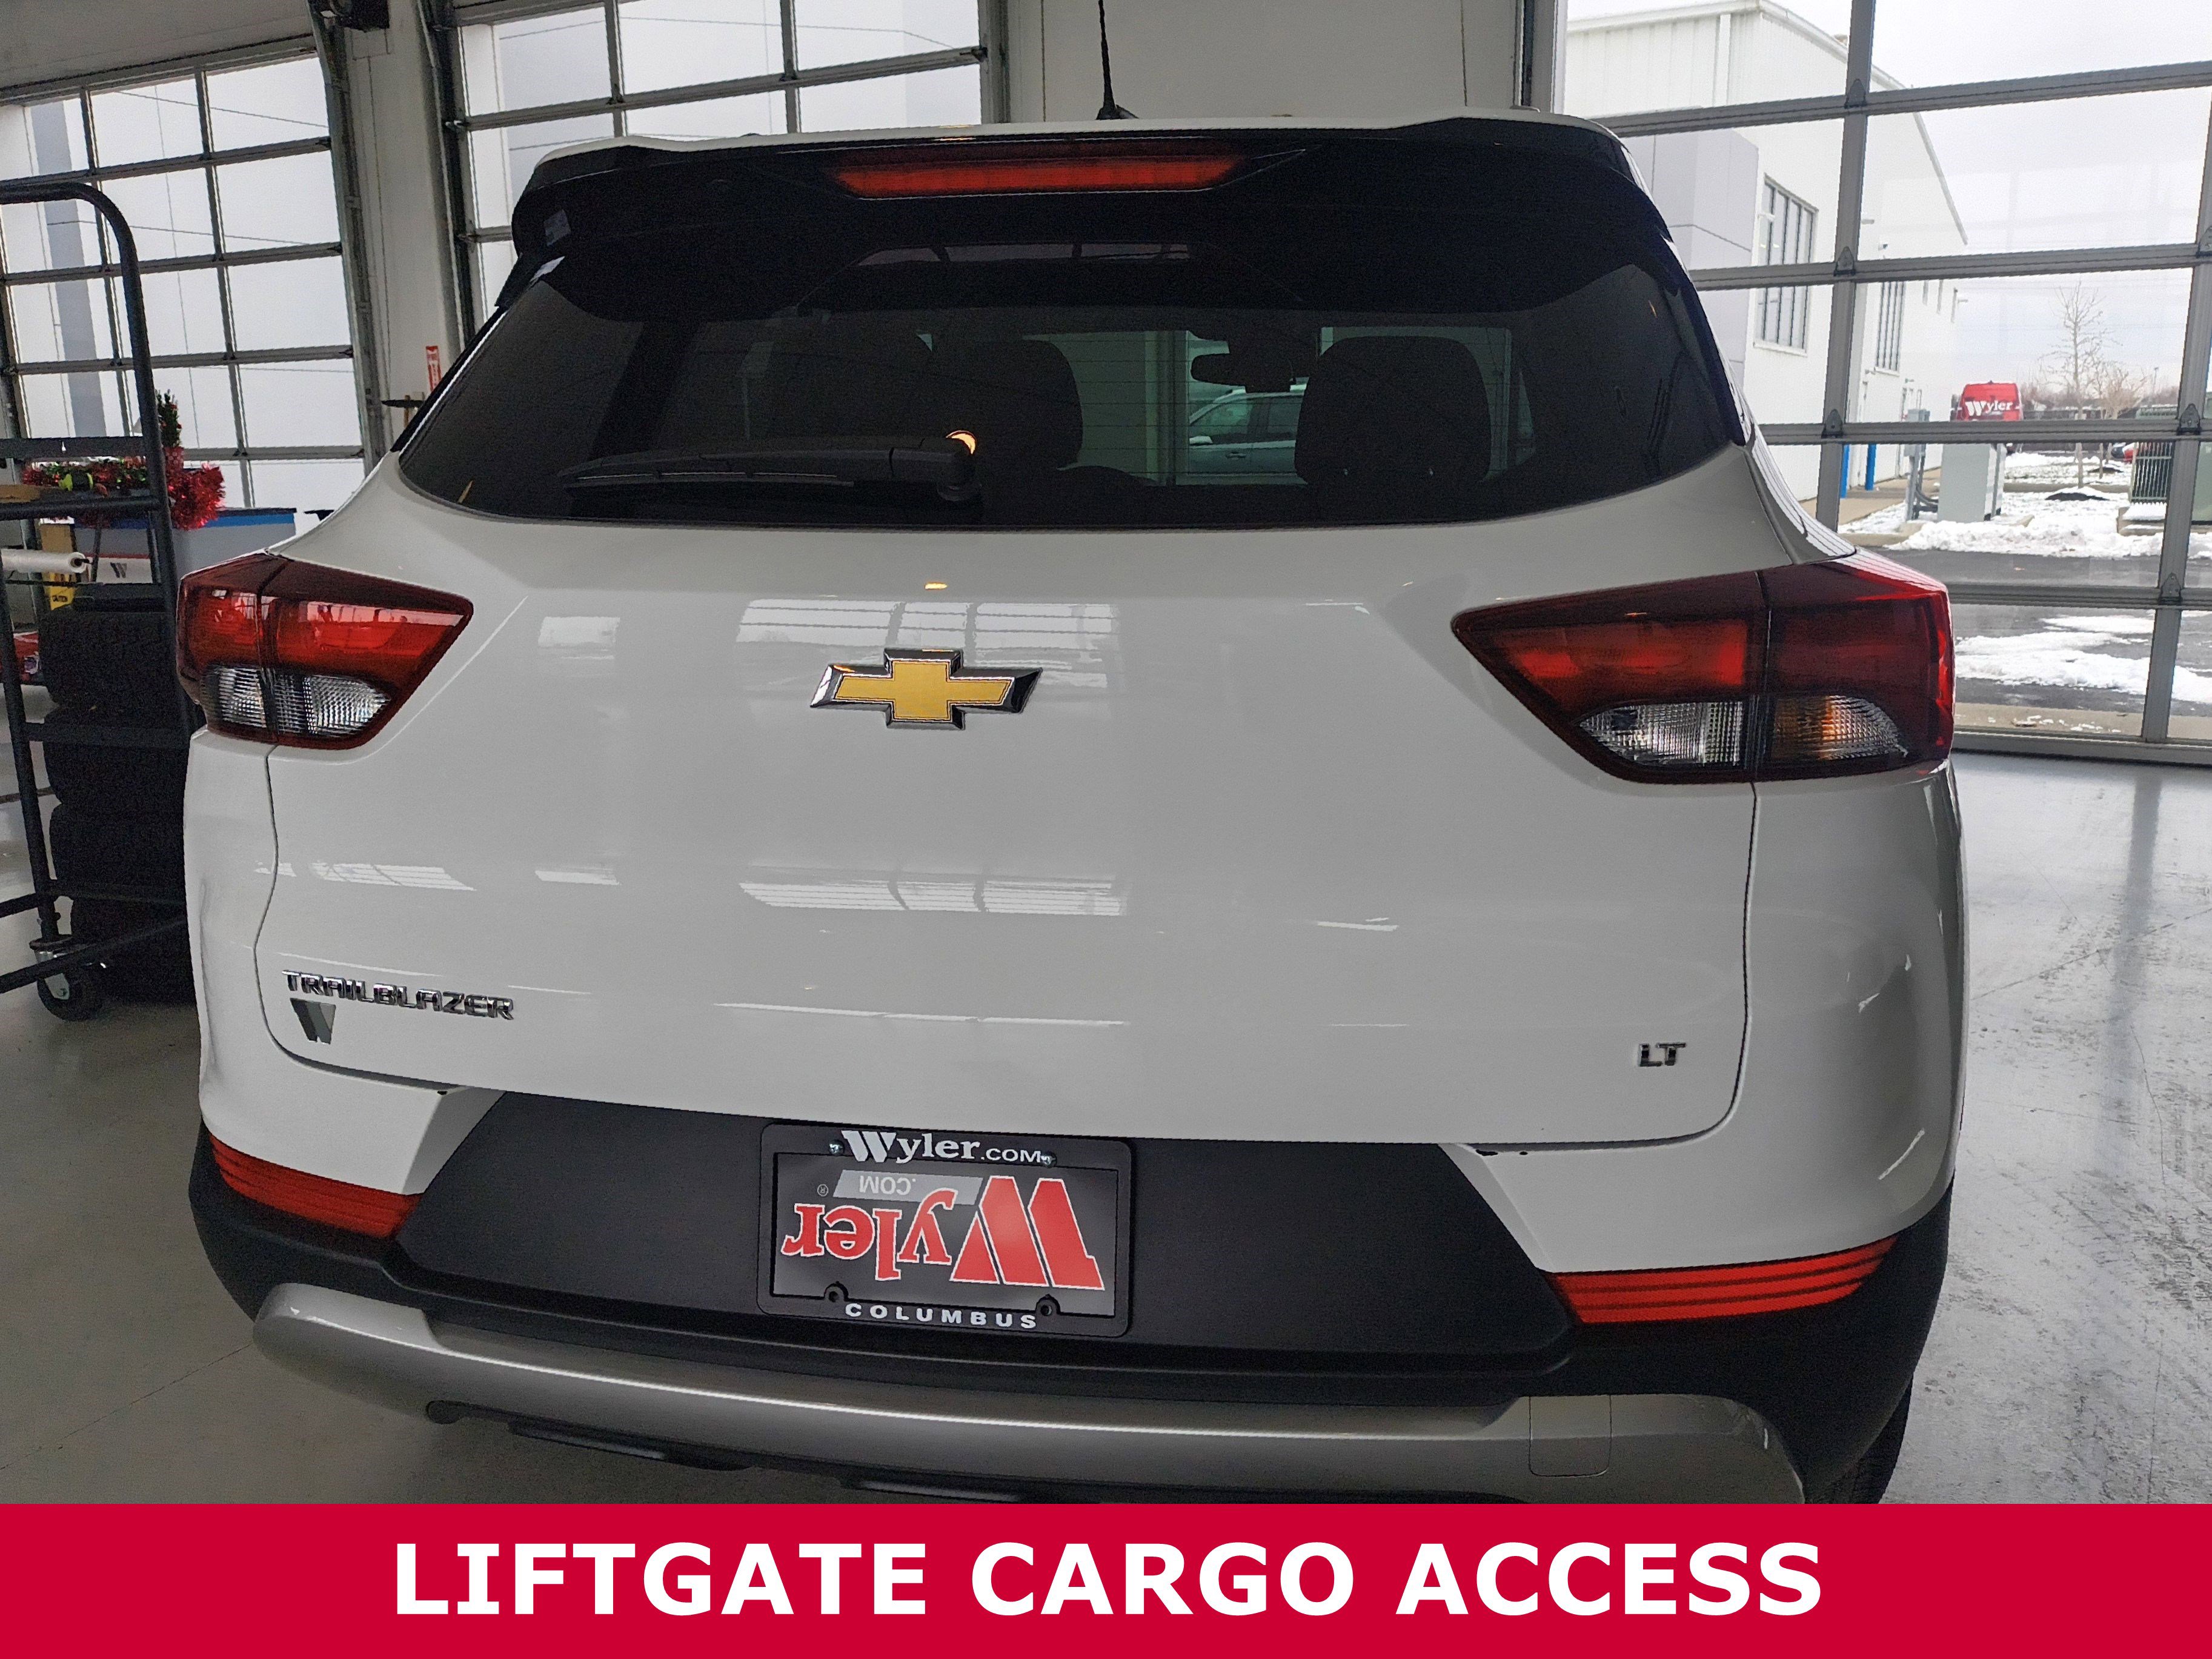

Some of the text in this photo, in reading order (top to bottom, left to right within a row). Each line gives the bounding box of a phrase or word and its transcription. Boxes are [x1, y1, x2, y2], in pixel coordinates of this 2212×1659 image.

[1965, 400, 2013, 416] Wyler
[282, 970, 514, 1020] TRAILBLAZER
[1638, 1042, 1687, 1067] LT
[781, 1175, 1105, 1291] Wyler
[845, 1303, 1037, 1329] COLUMBUS
